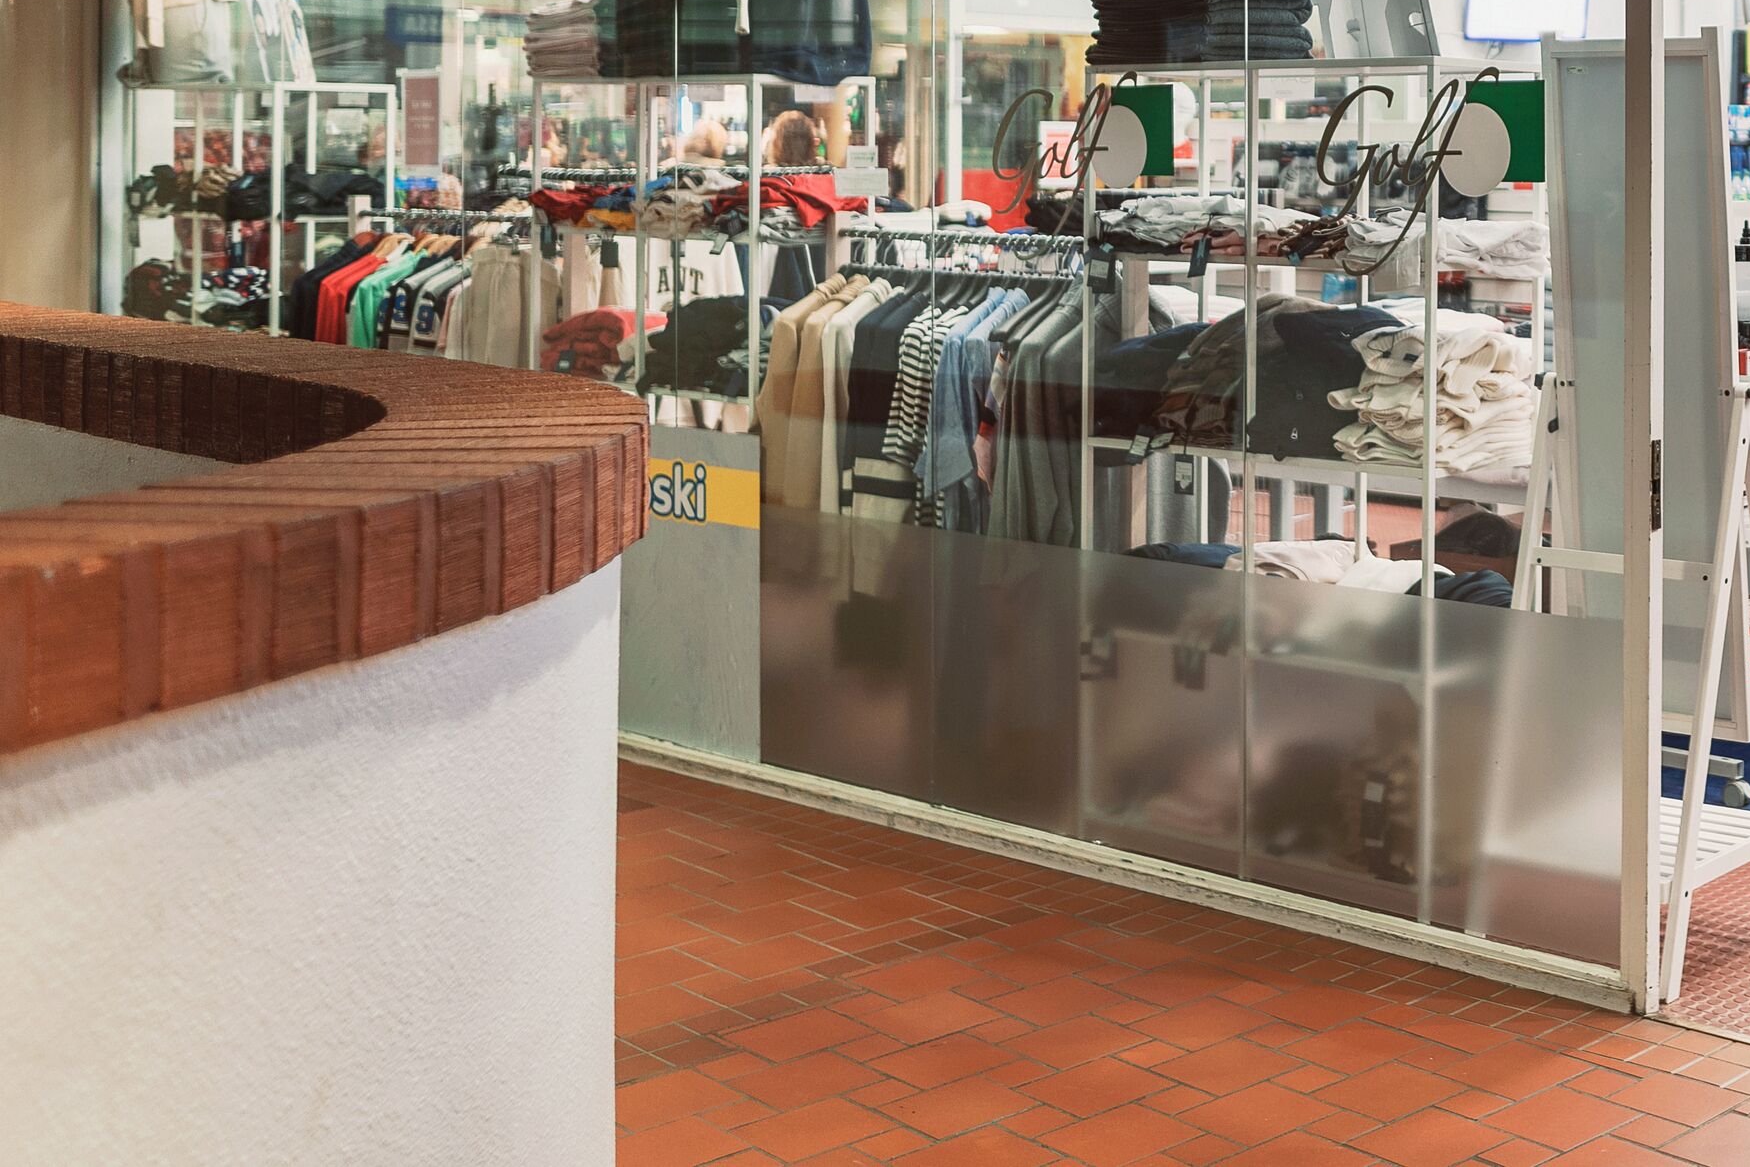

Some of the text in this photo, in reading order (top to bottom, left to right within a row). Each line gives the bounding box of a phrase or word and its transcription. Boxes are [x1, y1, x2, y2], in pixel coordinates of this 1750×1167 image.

[992, 70, 1138, 261] Golf
[1315, 65, 1500, 277] Golf
[648, 461, 707, 523] ski
